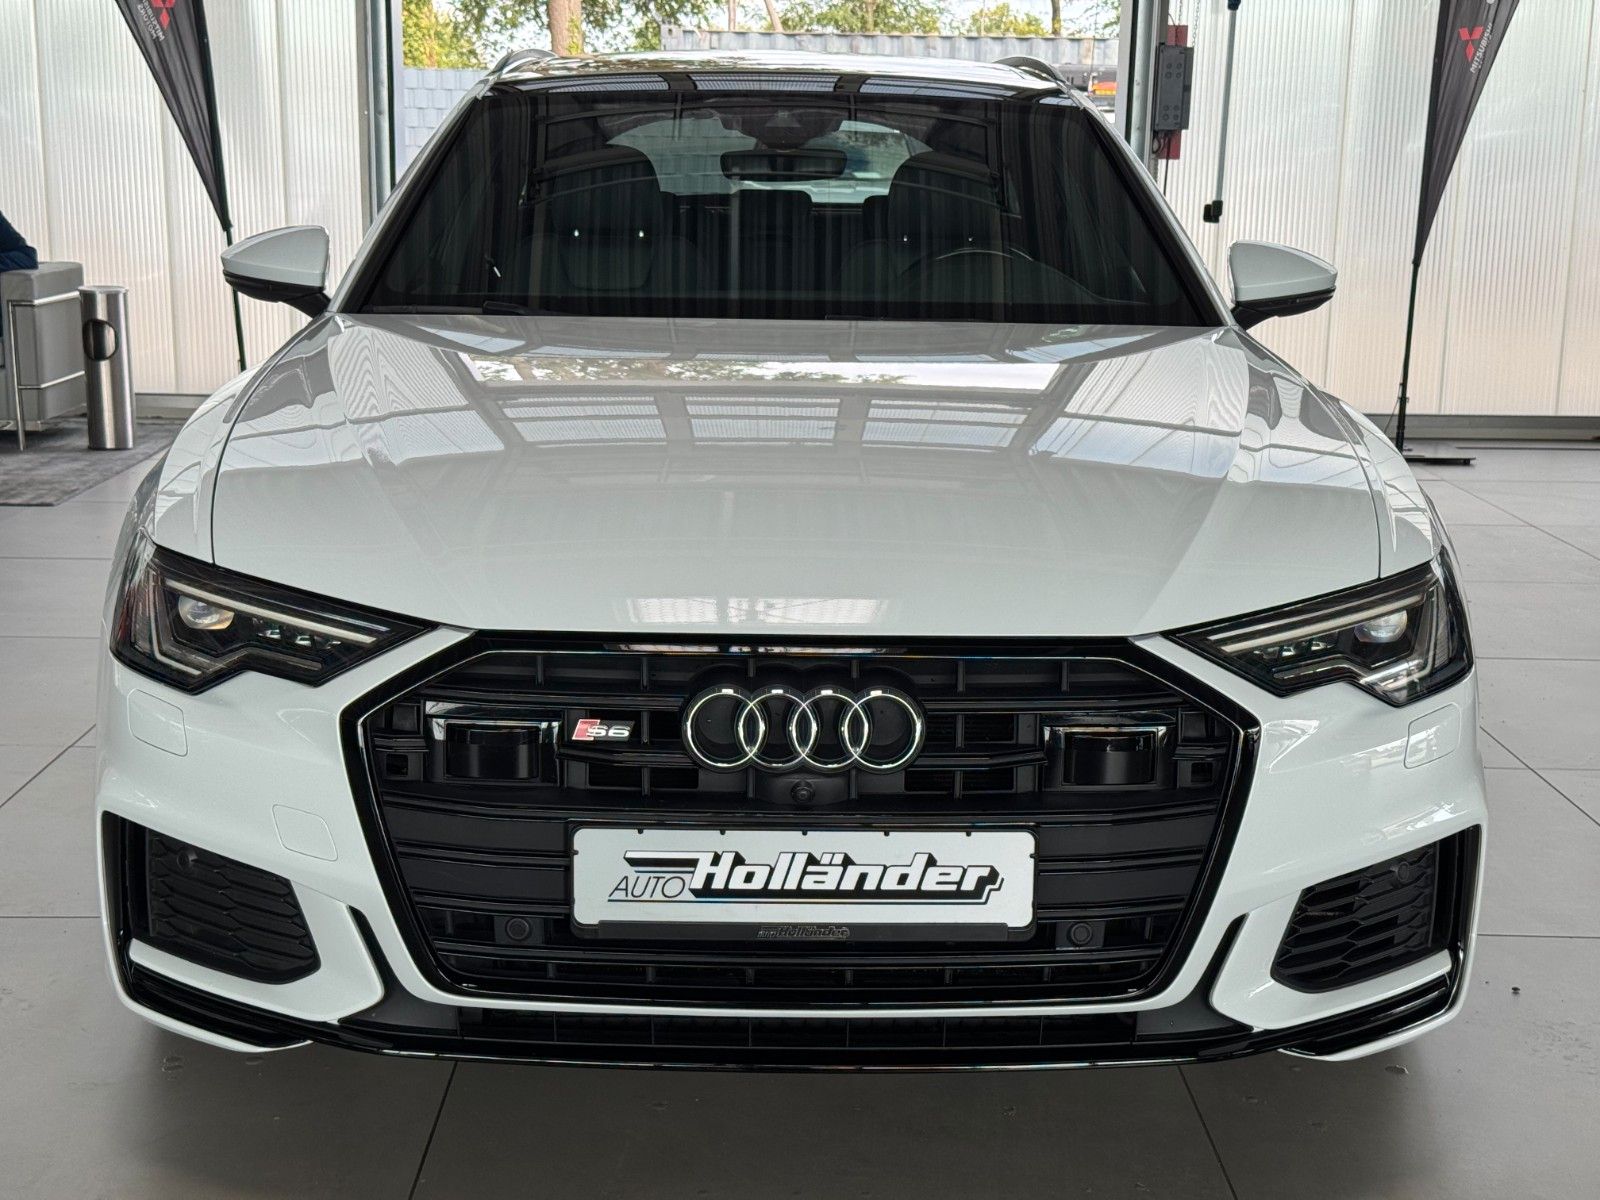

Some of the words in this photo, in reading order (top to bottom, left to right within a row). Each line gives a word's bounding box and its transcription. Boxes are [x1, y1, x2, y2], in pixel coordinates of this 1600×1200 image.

[586, 725, 631, 737] S6
[609, 875, 686, 899] AUTO
[687, 851, 1001, 900] Holländer
